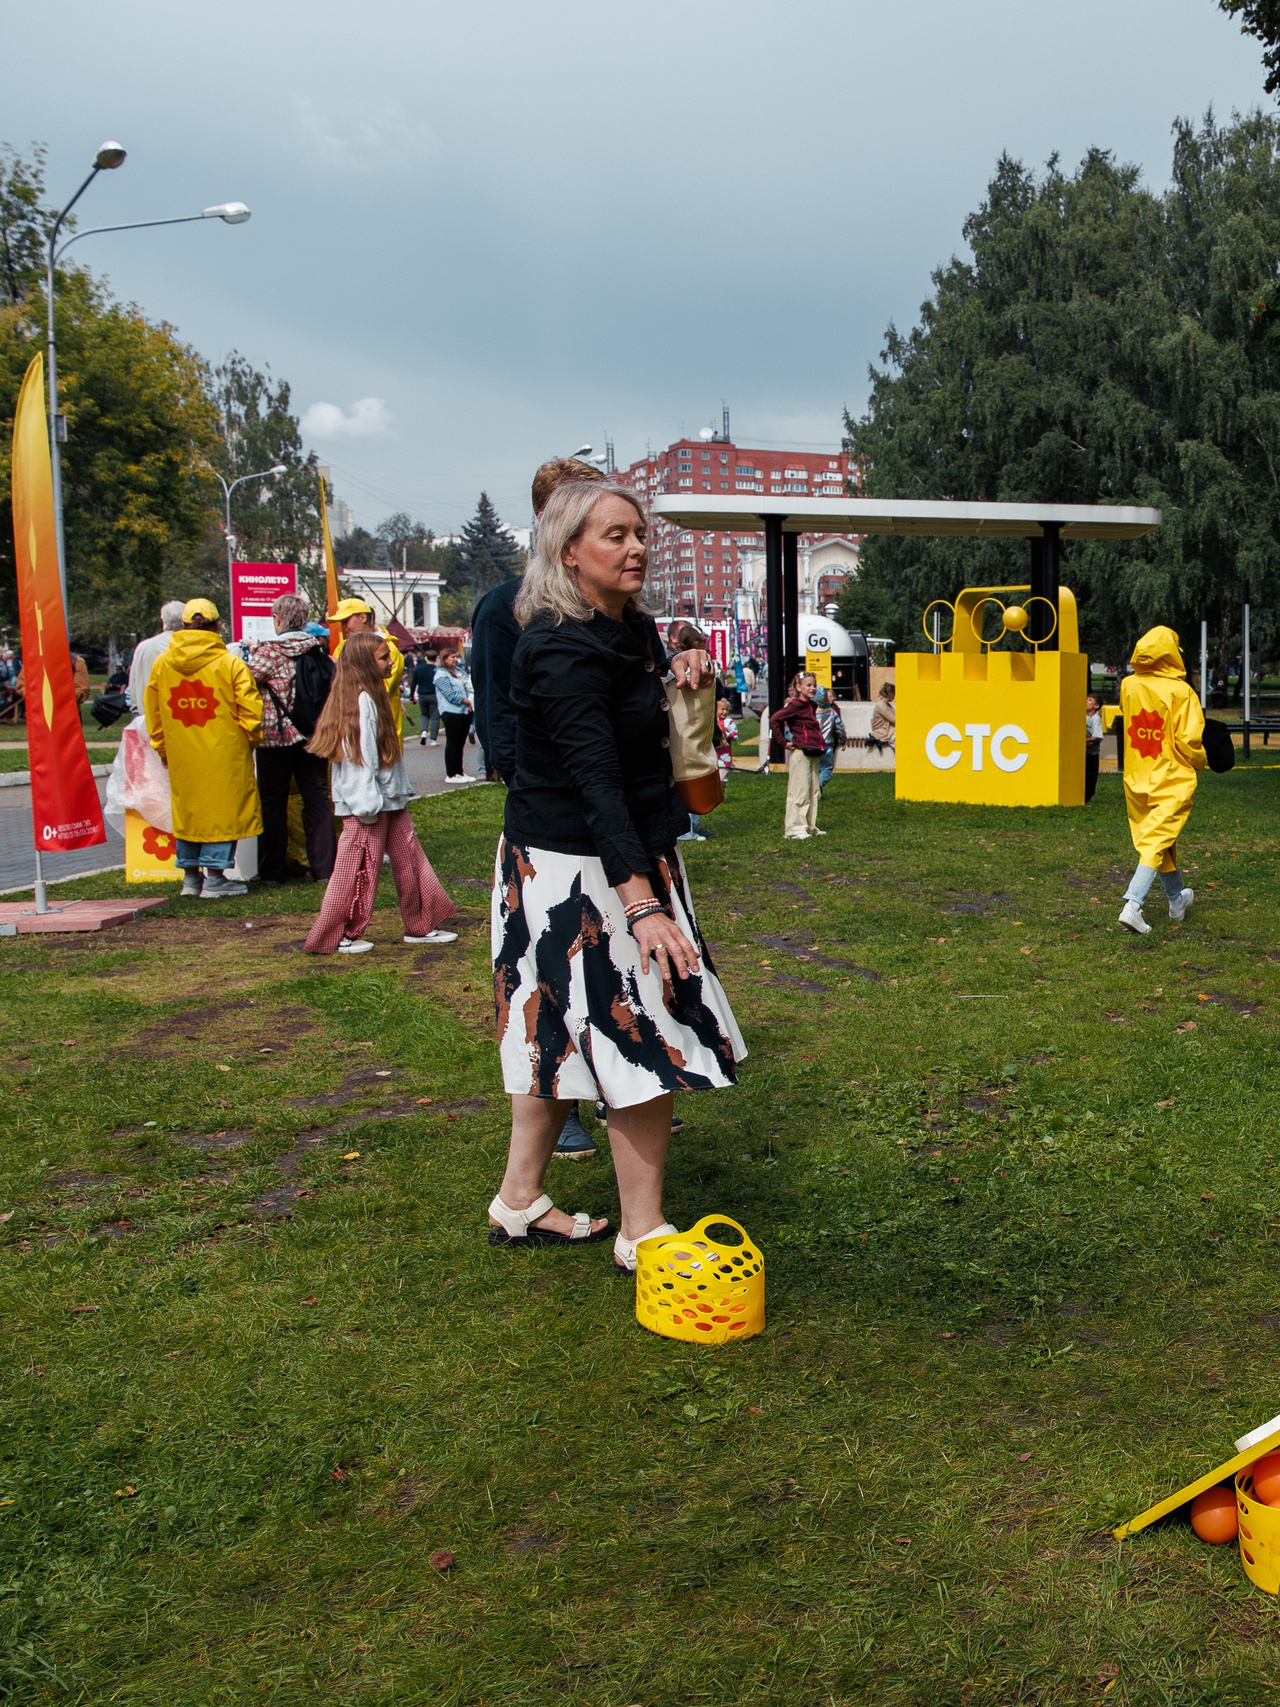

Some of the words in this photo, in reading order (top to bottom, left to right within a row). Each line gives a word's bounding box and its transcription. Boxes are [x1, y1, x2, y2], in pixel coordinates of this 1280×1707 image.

[238, 575, 290, 585] КИНОЛЕТО
[808, 633, 828, 647] Go
[177, 697, 208, 709] СТС
[1137, 727, 1162, 741] СТС
[925, 722, 1030, 773] СТС
